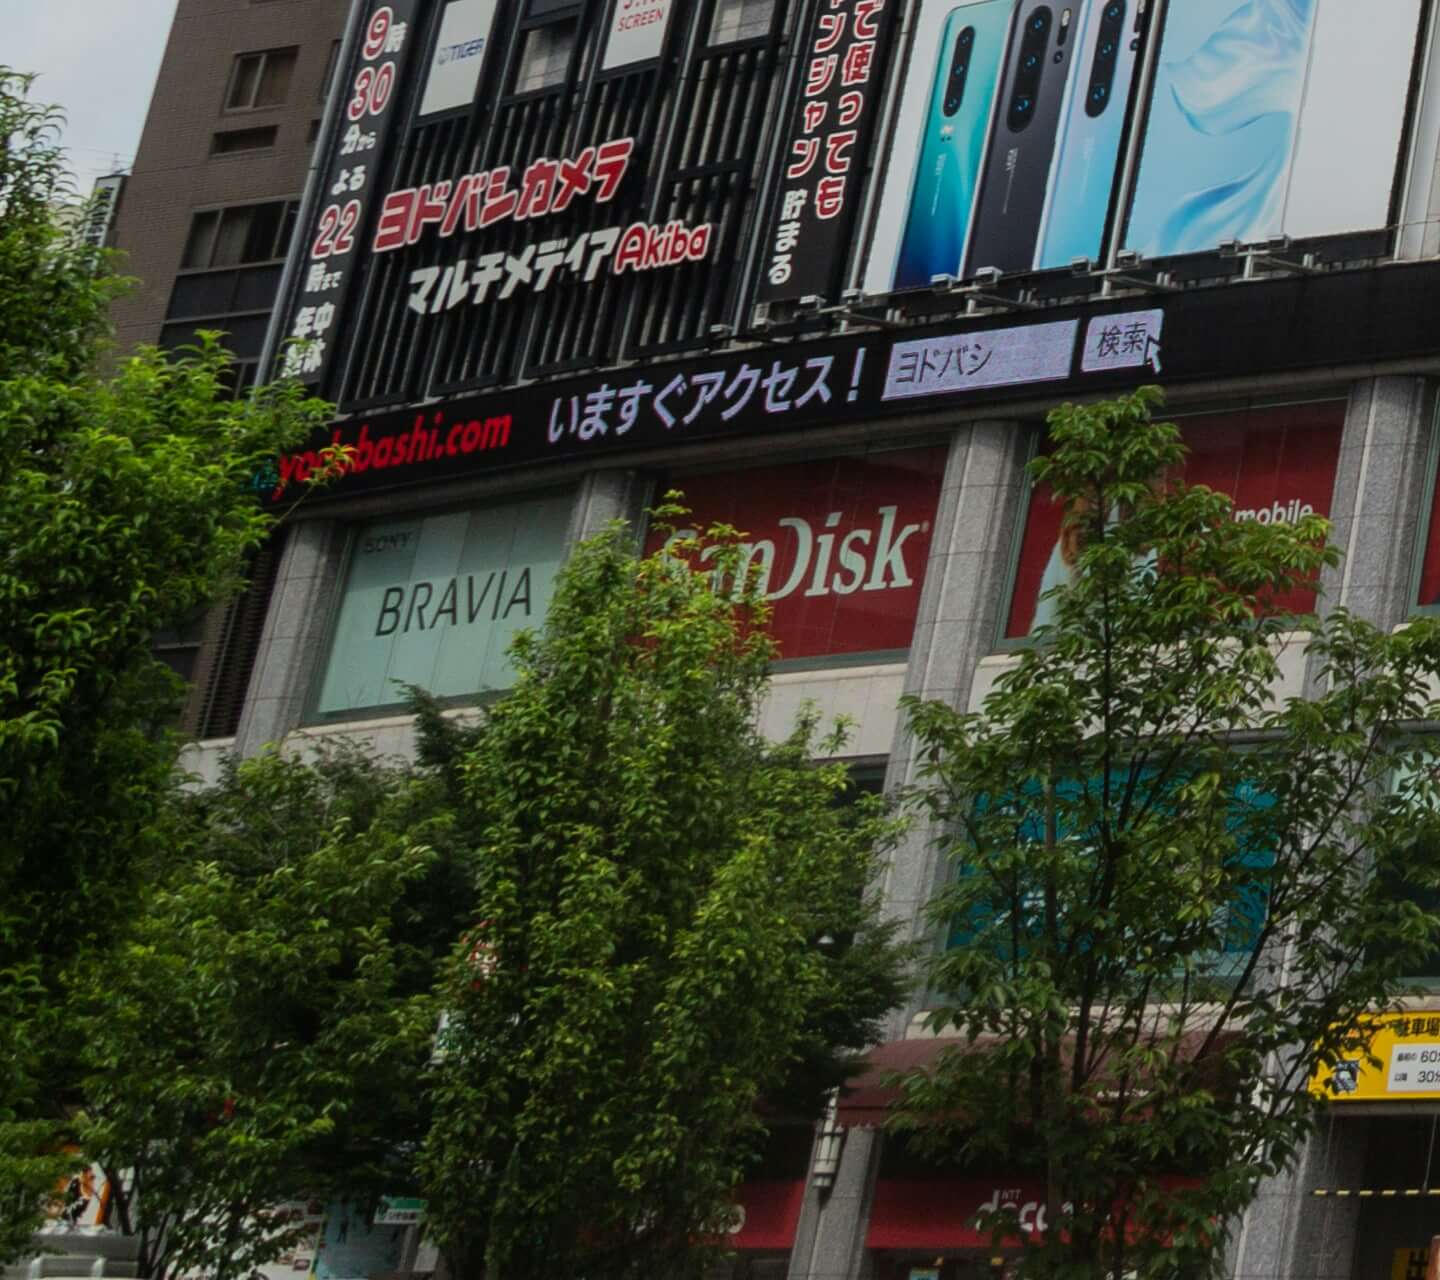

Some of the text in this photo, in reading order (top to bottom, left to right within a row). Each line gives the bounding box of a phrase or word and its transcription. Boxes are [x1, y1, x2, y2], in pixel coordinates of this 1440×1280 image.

[372, 137, 634, 254] ヨドバシカメラ
[408, 219, 712, 315] マルチメディア Akiba
[895, 343, 993, 384] ヨドバシ
[1096, 321, 1147, 357] 検索
[366, 533, 414, 553] SONY
[375, 566, 533, 636] BRAVIA
